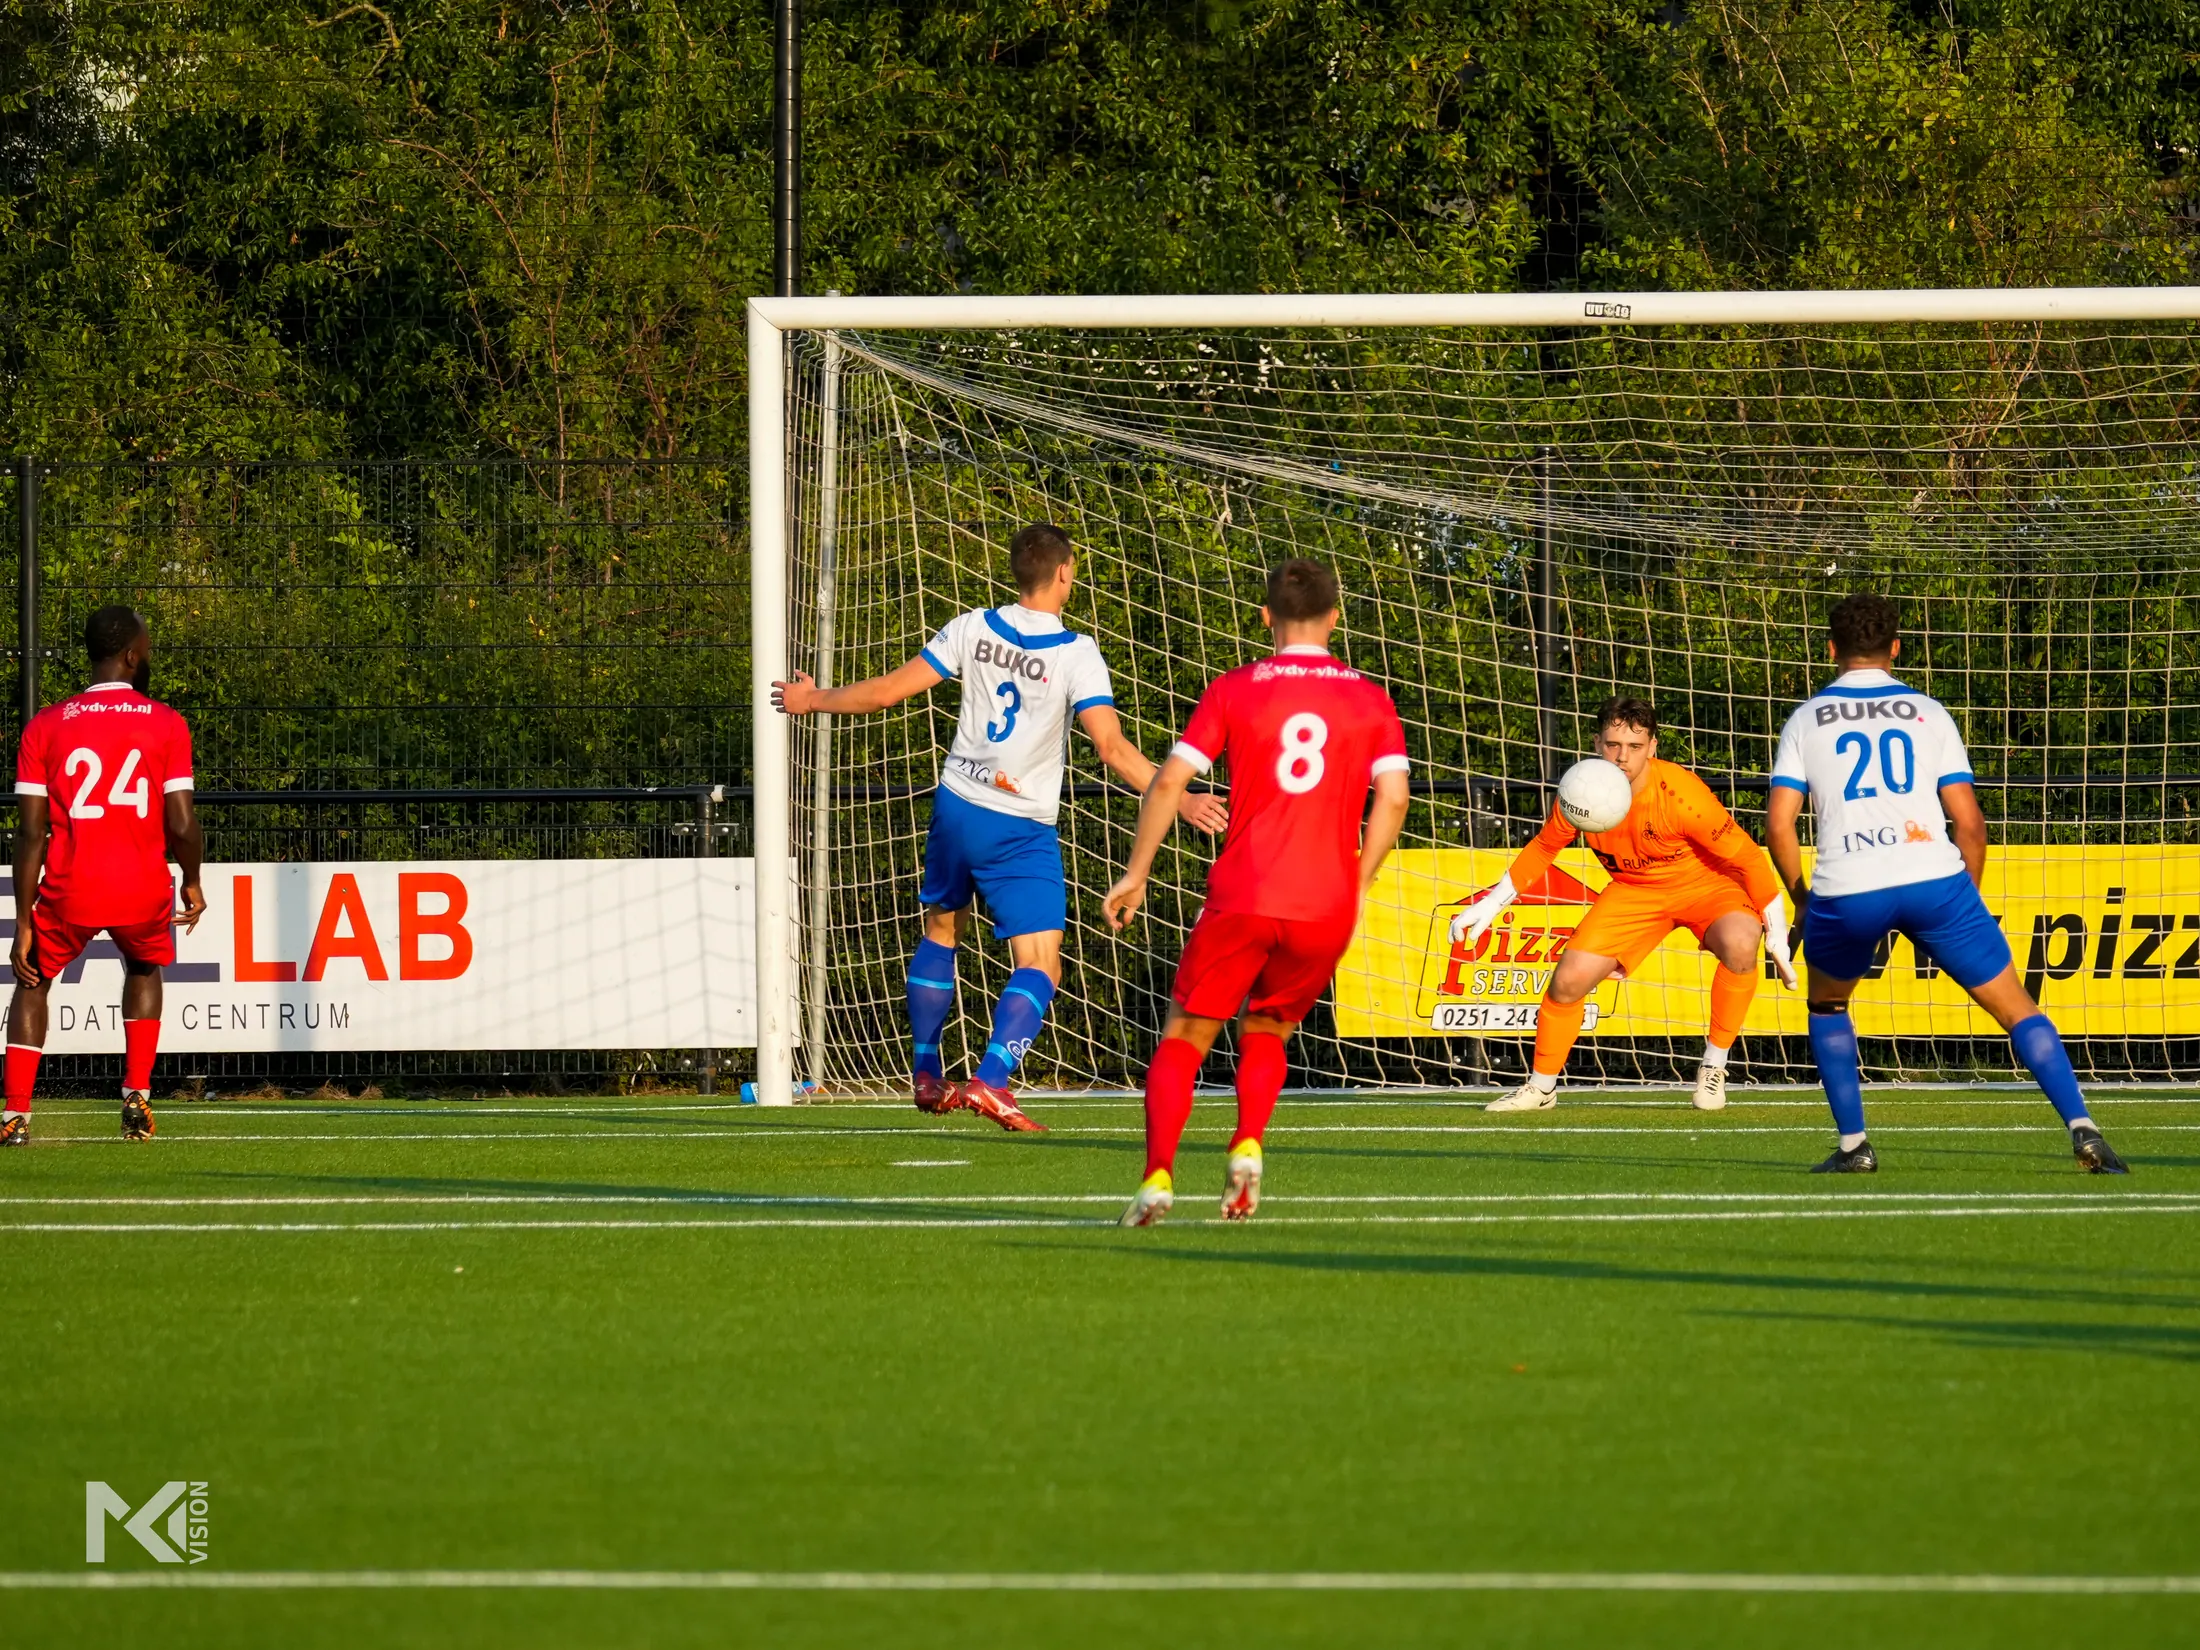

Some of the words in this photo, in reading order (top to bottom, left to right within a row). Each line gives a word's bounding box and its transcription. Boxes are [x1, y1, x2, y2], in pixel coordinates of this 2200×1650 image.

[987, 680, 1022, 742] 3
[64, 747, 149, 819] 24
[1275, 712, 1328, 794] 8
[1835, 728, 1915, 801] 20
[1842, 826, 1897, 854] ING
[1471, 968, 1598, 995] SERV
[181, 1002, 350, 1031] CENTRUM
